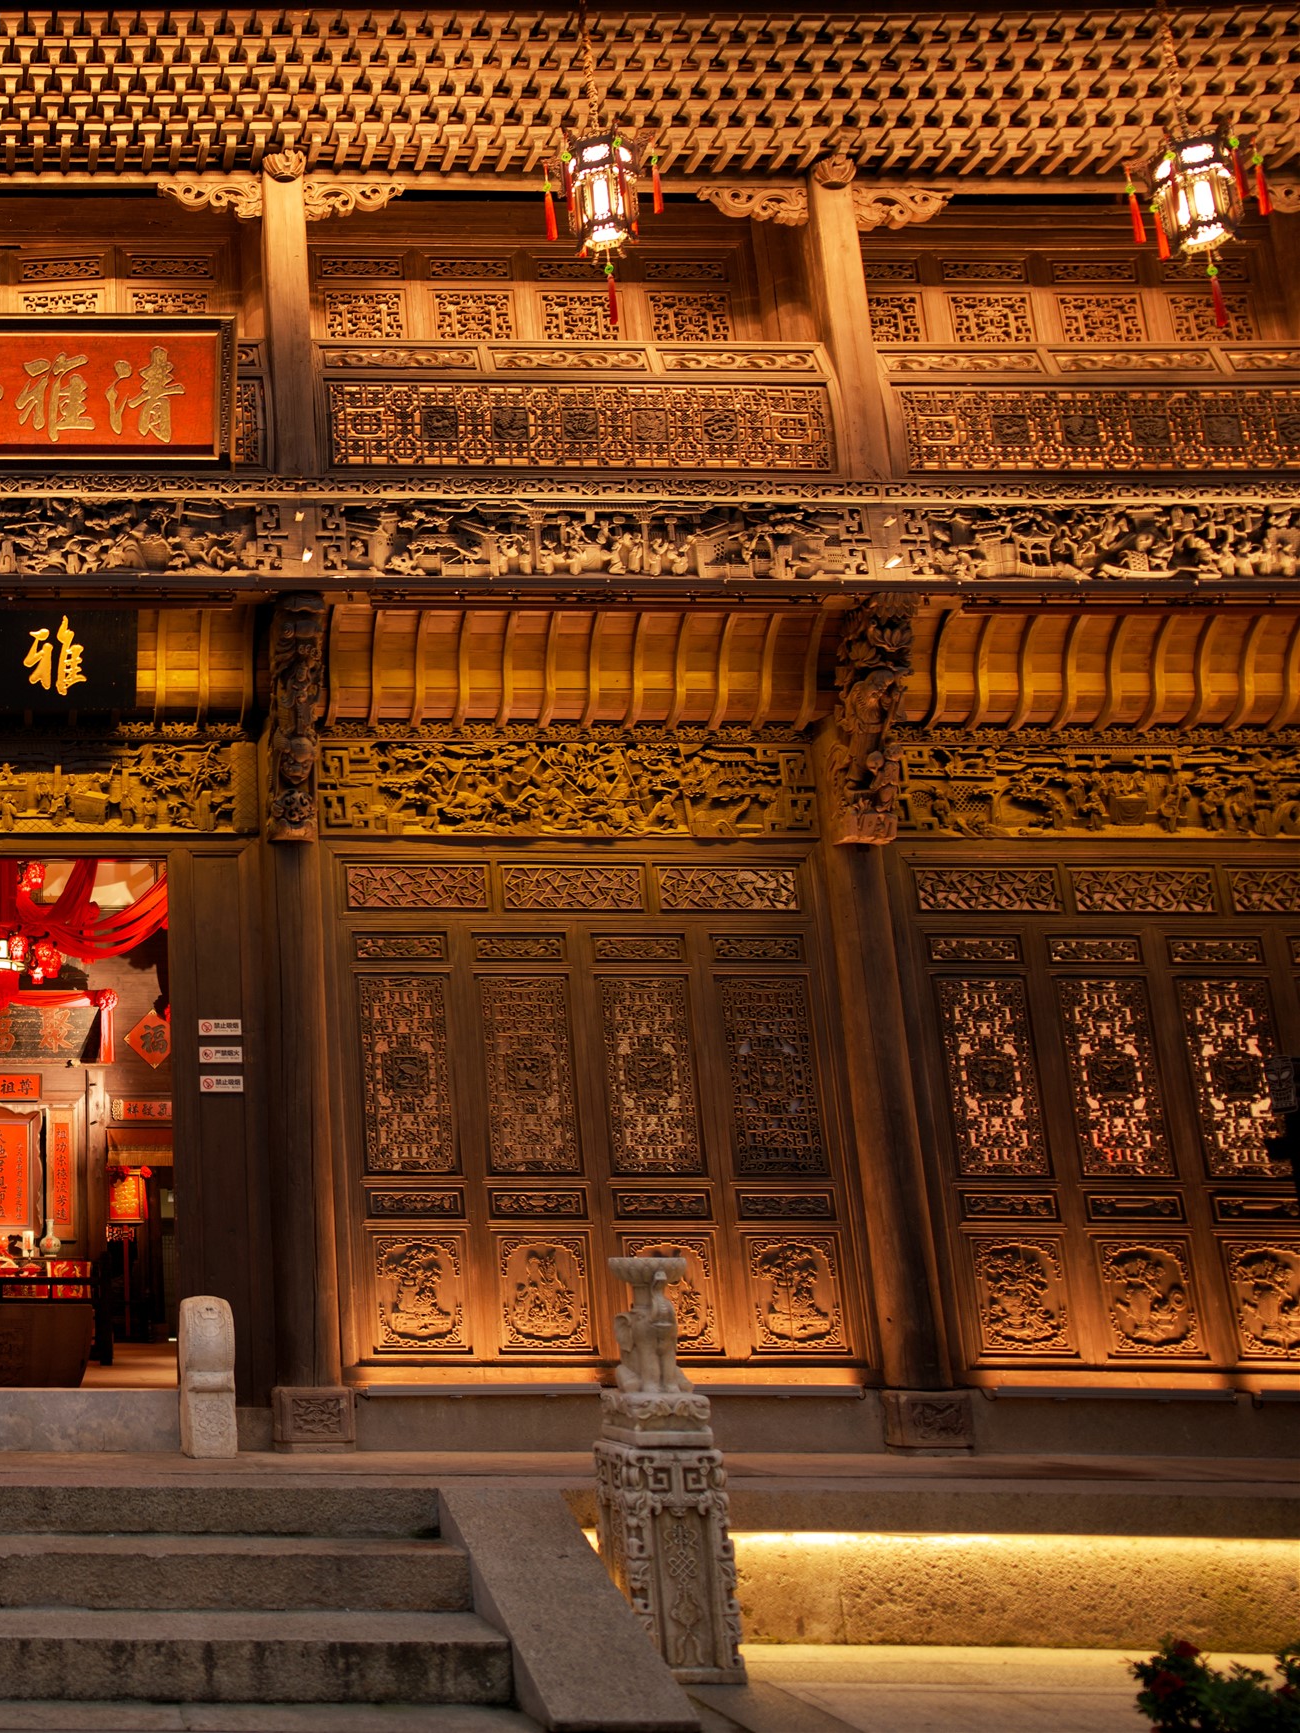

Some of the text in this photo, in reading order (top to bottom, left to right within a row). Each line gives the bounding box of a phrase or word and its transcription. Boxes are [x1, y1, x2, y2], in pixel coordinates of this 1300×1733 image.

[140, 1024, 168, 1054] 福
[214, 1049, 240, 1057] 严禁烟火
[216, 1078, 241, 1086] 禁止吸烟
